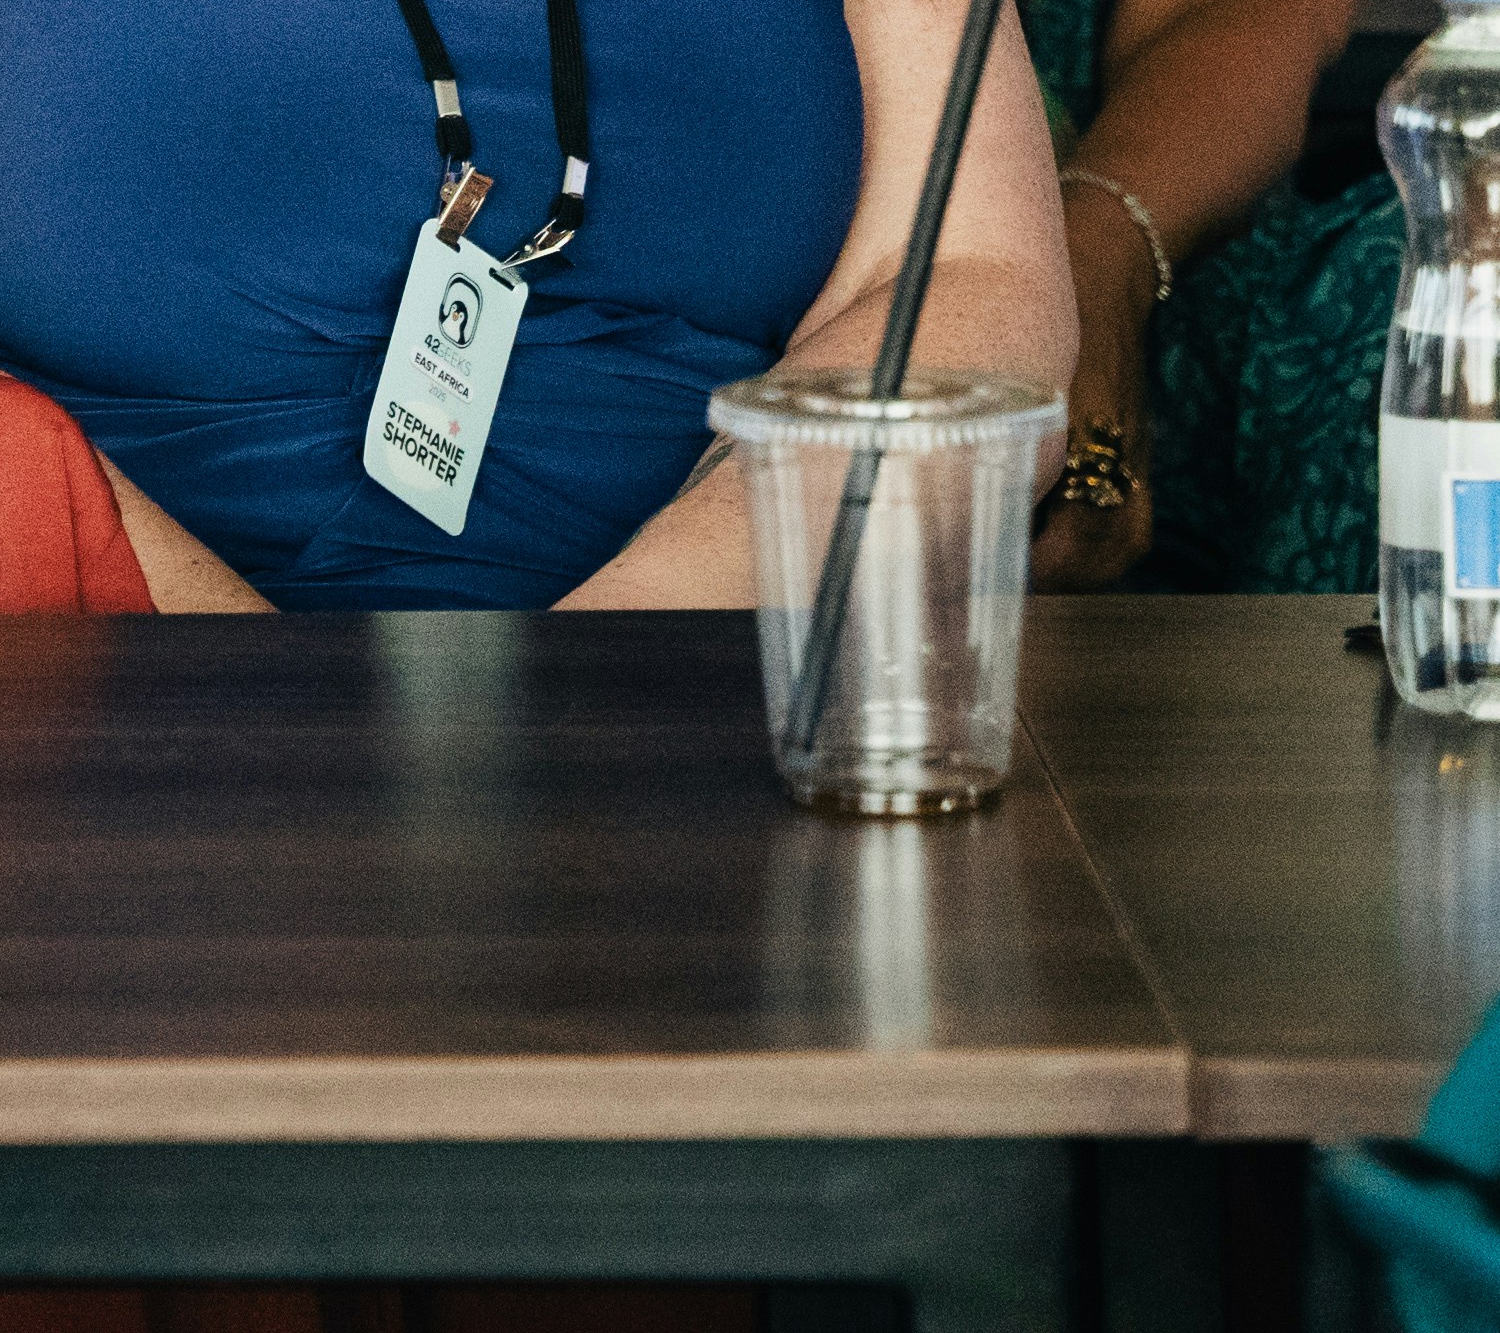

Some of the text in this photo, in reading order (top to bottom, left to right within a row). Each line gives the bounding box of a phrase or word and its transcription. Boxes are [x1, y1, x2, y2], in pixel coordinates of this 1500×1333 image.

[414, 352, 469, 399] EAST AFRICA
[382, 421, 457, 487] SHORTER
[386, 400, 465, 467] STEPHANIE
